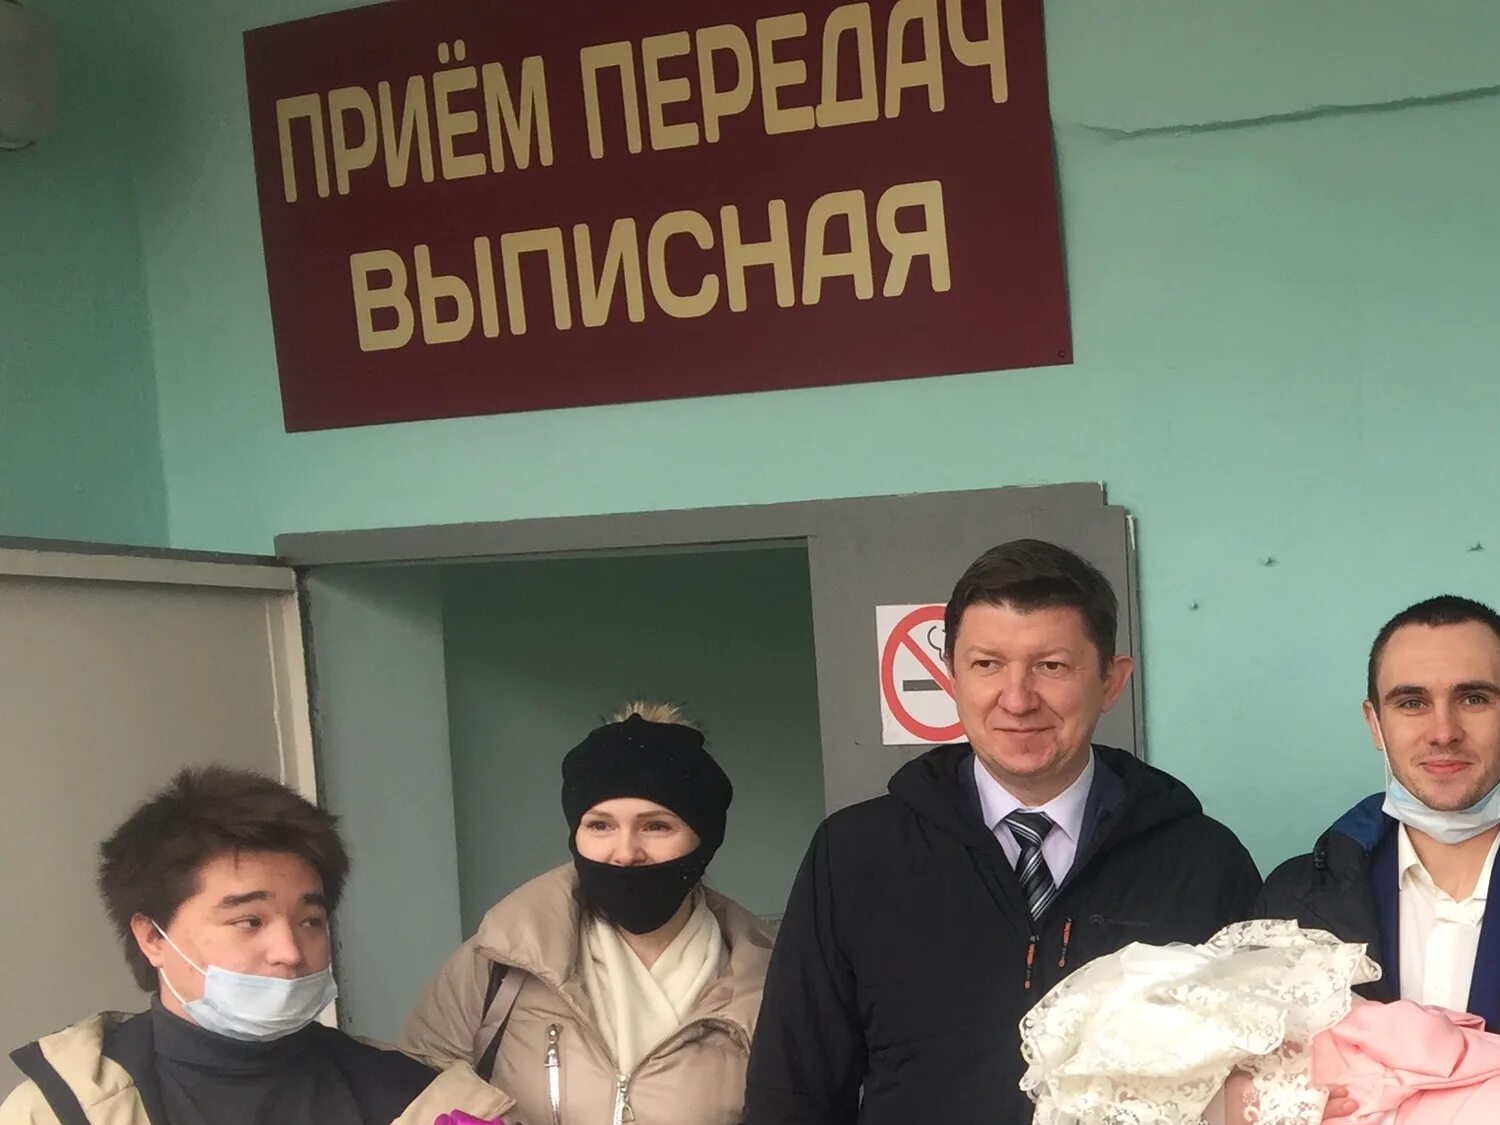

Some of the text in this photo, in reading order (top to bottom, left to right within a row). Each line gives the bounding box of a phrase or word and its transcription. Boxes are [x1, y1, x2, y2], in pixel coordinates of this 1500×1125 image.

[275, 0, 1009, 203] ПРИЁМ ПЕРЕДАЧ
[349, 179, 952, 352] ВЫПИСНАЯ
